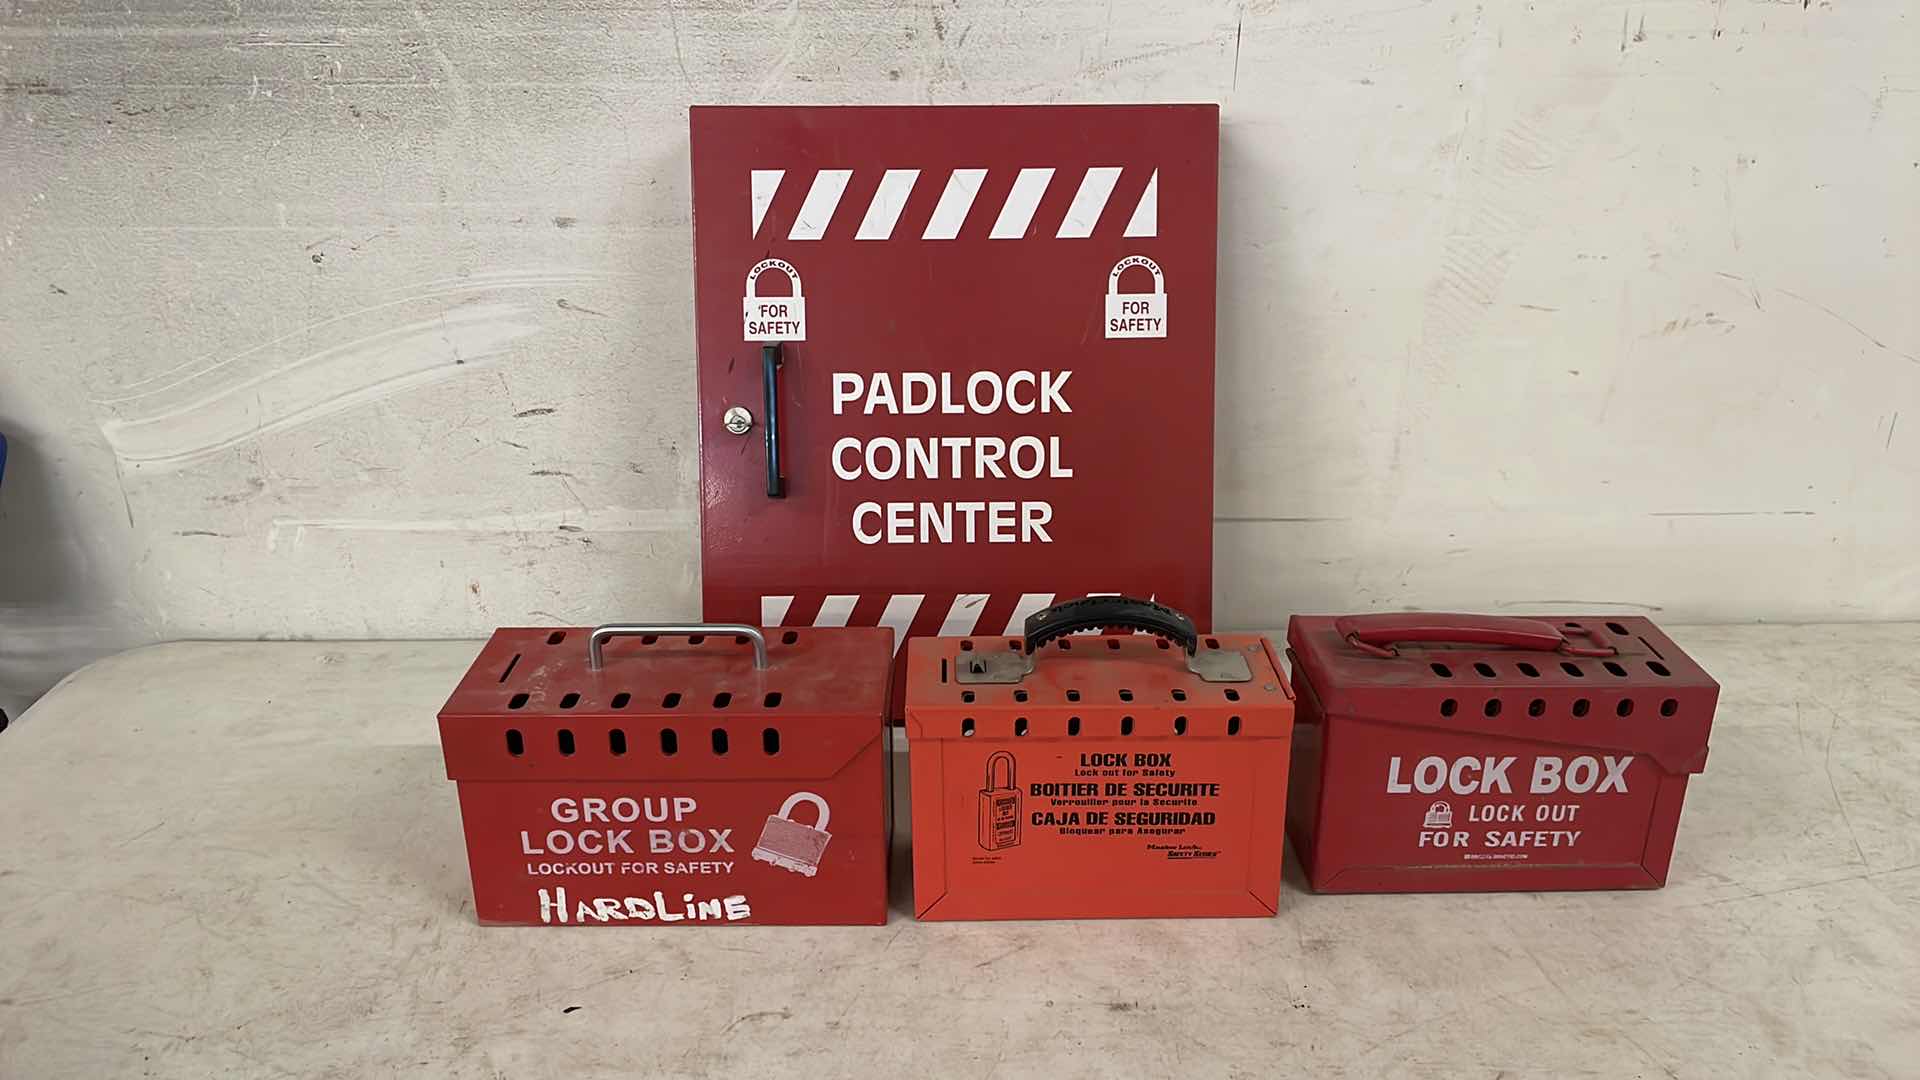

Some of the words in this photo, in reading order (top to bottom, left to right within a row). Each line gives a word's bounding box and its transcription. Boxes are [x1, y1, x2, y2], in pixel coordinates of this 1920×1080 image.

[750, 261, 798, 280] LOCKOUT
[1112, 257, 1160, 277] LOCKOUT
[761, 304, 788, 318] FOR
[1122, 301, 1150, 315] FOR
[748, 321, 800, 335] SAFETY
[1110, 318, 1161, 332] SAFETY
[832, 370, 1073, 415] PADLOCK
[831, 435, 1073, 480] CONTROL
[852, 500, 1053, 545] CENTER
[1080, 753, 1128, 767] LOCK
[1134, 753, 1172, 767] BOX
[1075, 768, 1099, 777] Lock
[1102, 769, 1119, 777] out
[1122, 768, 1139, 777] for
[1142, 768, 1176, 778] Safety
[1386, 755, 1518, 795] LOCK
[1529, 755, 1635, 794] BOX
[1030, 783, 1099, 797] BOITIER
[1104, 783, 1128, 797] DE
[1133, 783, 1220, 797] SECURITE
[551, 797, 697, 823] GROUP
[1112, 799, 1137, 807] pour
[1152, 798, 1198, 806] Securite
[1031, 812, 1080, 826] CAJA
[1086, 812, 1109, 825] DE
[1113, 811, 1216, 826] SEGURIDAD
[1468, 804, 1526, 822] LOCK
[1535, 804, 1580, 822] OUT
[1059, 826, 1106, 836] Bloquear
[1108, 828, 1133, 836] para
[1136, 826, 1186, 836] Asegurar
[520, 829, 635, 855] LOCK
[649, 828, 735, 854] BOX
[1418, 831, 1470, 848] FOR
[1484, 830, 1582, 847] SAFETY
[527, 862, 615, 876] LOCKOUT
[621, 862, 659, 875] FOR
[663, 861, 735, 875] SAFETY
